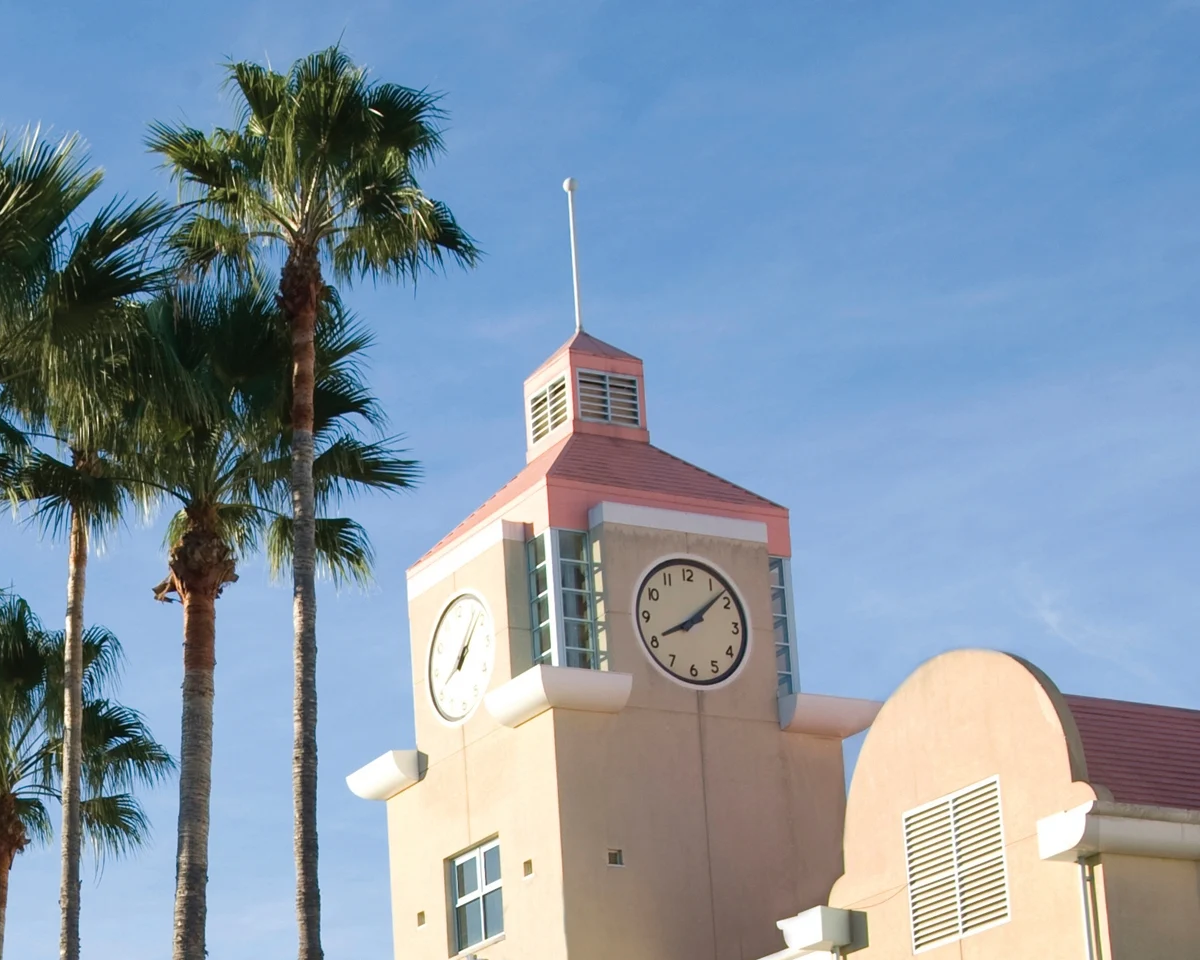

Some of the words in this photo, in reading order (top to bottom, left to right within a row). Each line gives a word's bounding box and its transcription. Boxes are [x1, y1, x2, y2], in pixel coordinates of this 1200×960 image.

[663, 572, 672, 586] 11
[682, 568, 694, 582] 12
[709, 578, 713, 591] 1
[648, 587, 660, 601] 10
[723, 597, 731, 609] 2
[642, 610, 650, 623] 9
[731, 622, 739, 635] 3
[650, 635, 659, 648] 8
[725, 645, 734, 658] 4
[668, 654, 676, 667] 7
[710, 660, 719, 673] 5
[689, 664, 698, 677] 6
